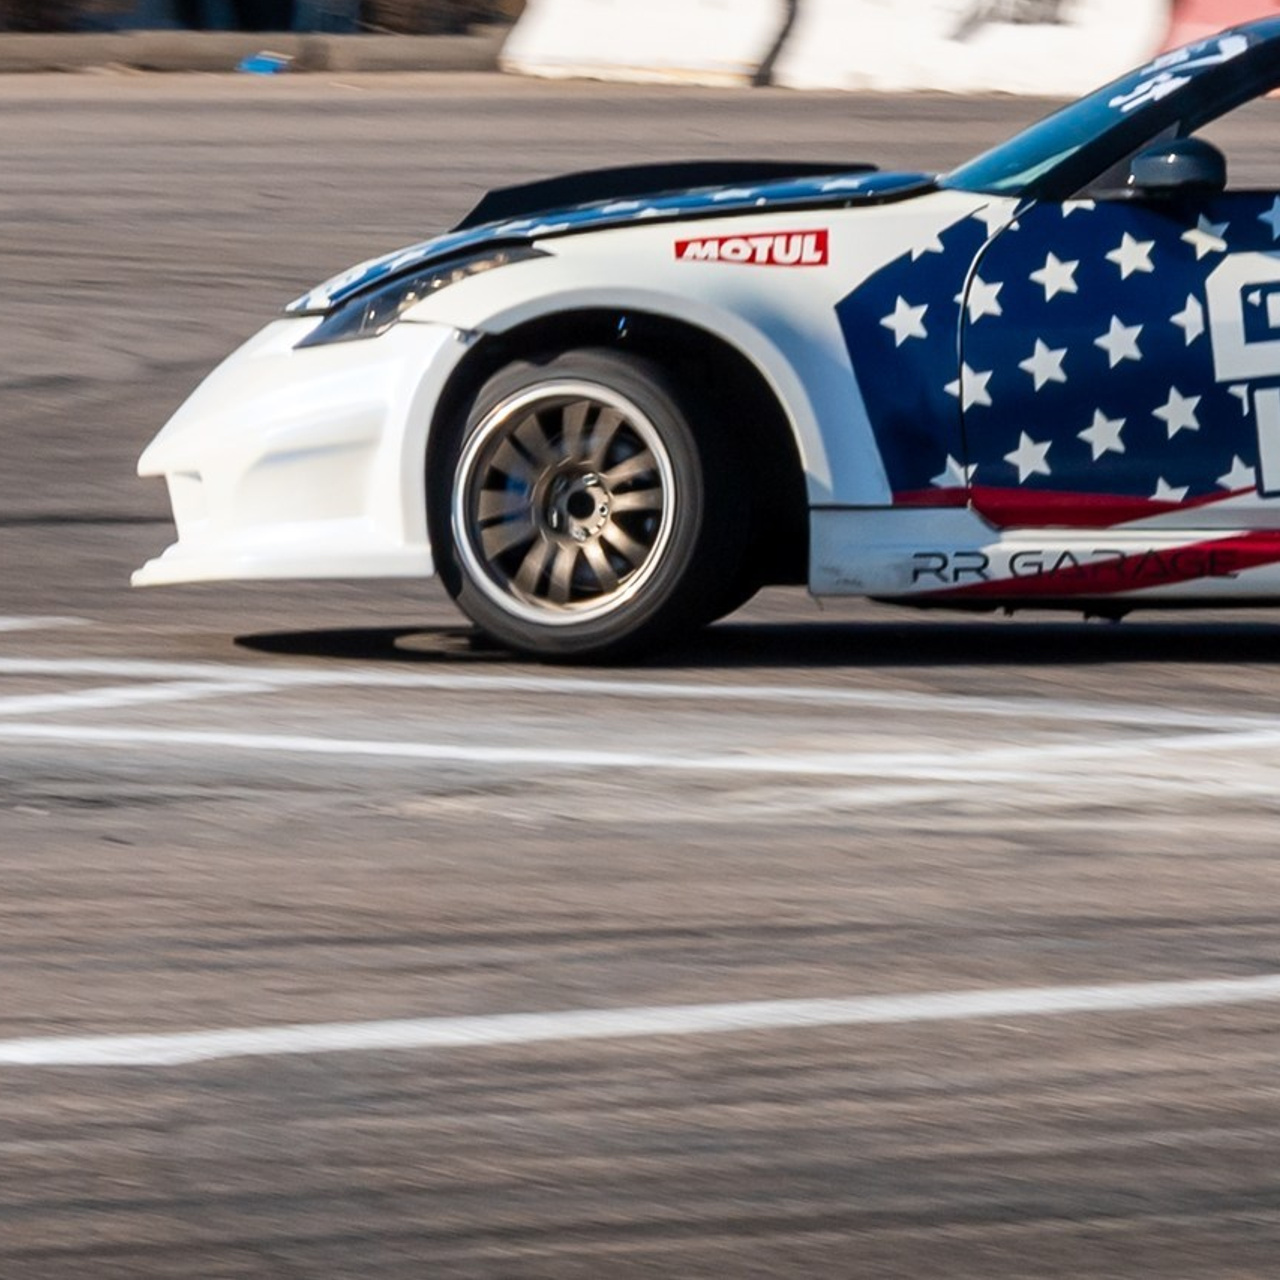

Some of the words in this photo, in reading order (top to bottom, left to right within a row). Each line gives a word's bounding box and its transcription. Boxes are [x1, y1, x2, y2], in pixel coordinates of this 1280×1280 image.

[681, 233, 824, 265] MOTUL
[911, 551, 991, 585] RR
[1008, 549, 1240, 580] GARAGE
